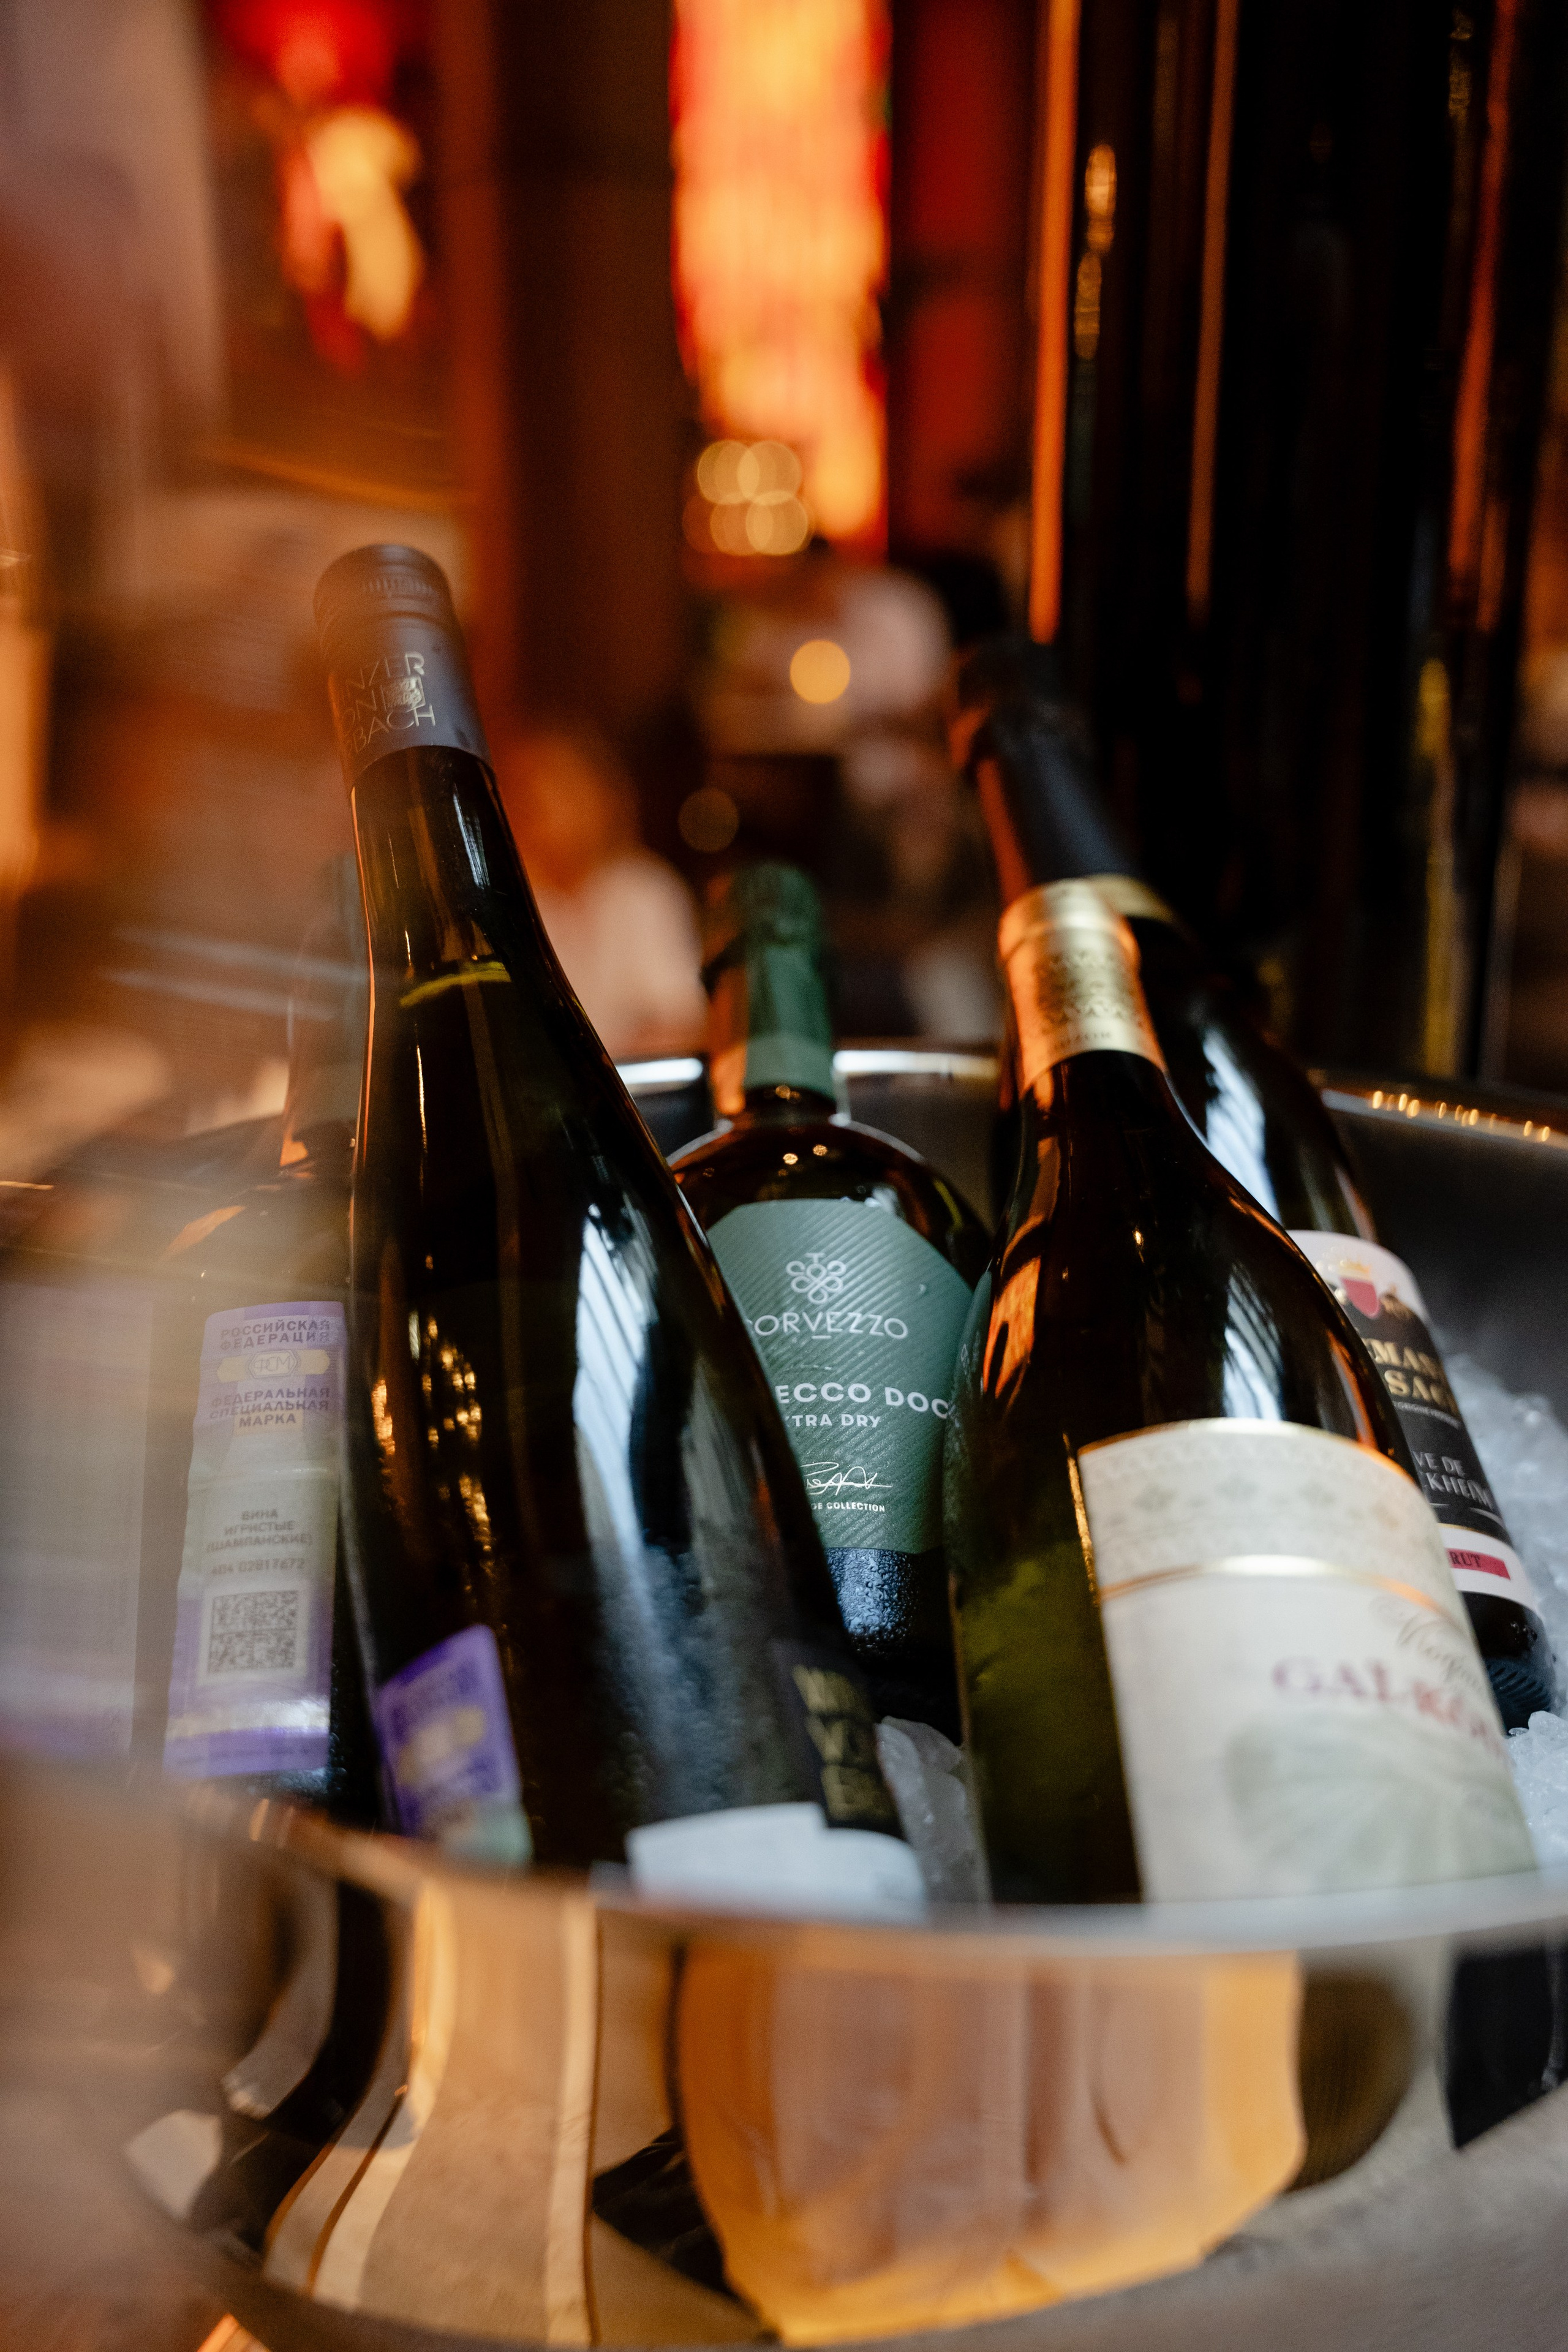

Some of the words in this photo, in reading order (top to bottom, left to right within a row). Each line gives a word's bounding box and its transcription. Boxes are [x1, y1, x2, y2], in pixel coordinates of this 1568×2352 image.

[221, 1319, 330, 1340] РОССИЙСКАЯ
[749, 1311, 909, 1340] ORVEZZO
[220, 1332, 330, 1351] ФЕДЕРАЦИЯ
[211, 1387, 330, 1408] ФЕДЕРАЛЬНАЯ
[775, 1382, 872, 1403] ECCO
[884, 1387, 951, 1419] DOC
[209, 1400, 329, 1419] СПЕЦИАЛЬНАЯ
[239, 1413, 296, 1428] МАРКА
[841, 1413, 881, 1428] DRY
[1412, 1450, 1439, 1470] VE
[1441, 1455, 1466, 1477] DE
[1421, 1471, 1493, 1510] KHEIM
[241, 1509, 279, 1520] ВИНА
[826, 1501, 886, 1512] COLLECTION
[224, 1520, 295, 1536] ИГРИСТЫЕ
[1449, 1551, 1482, 1568] RUT
